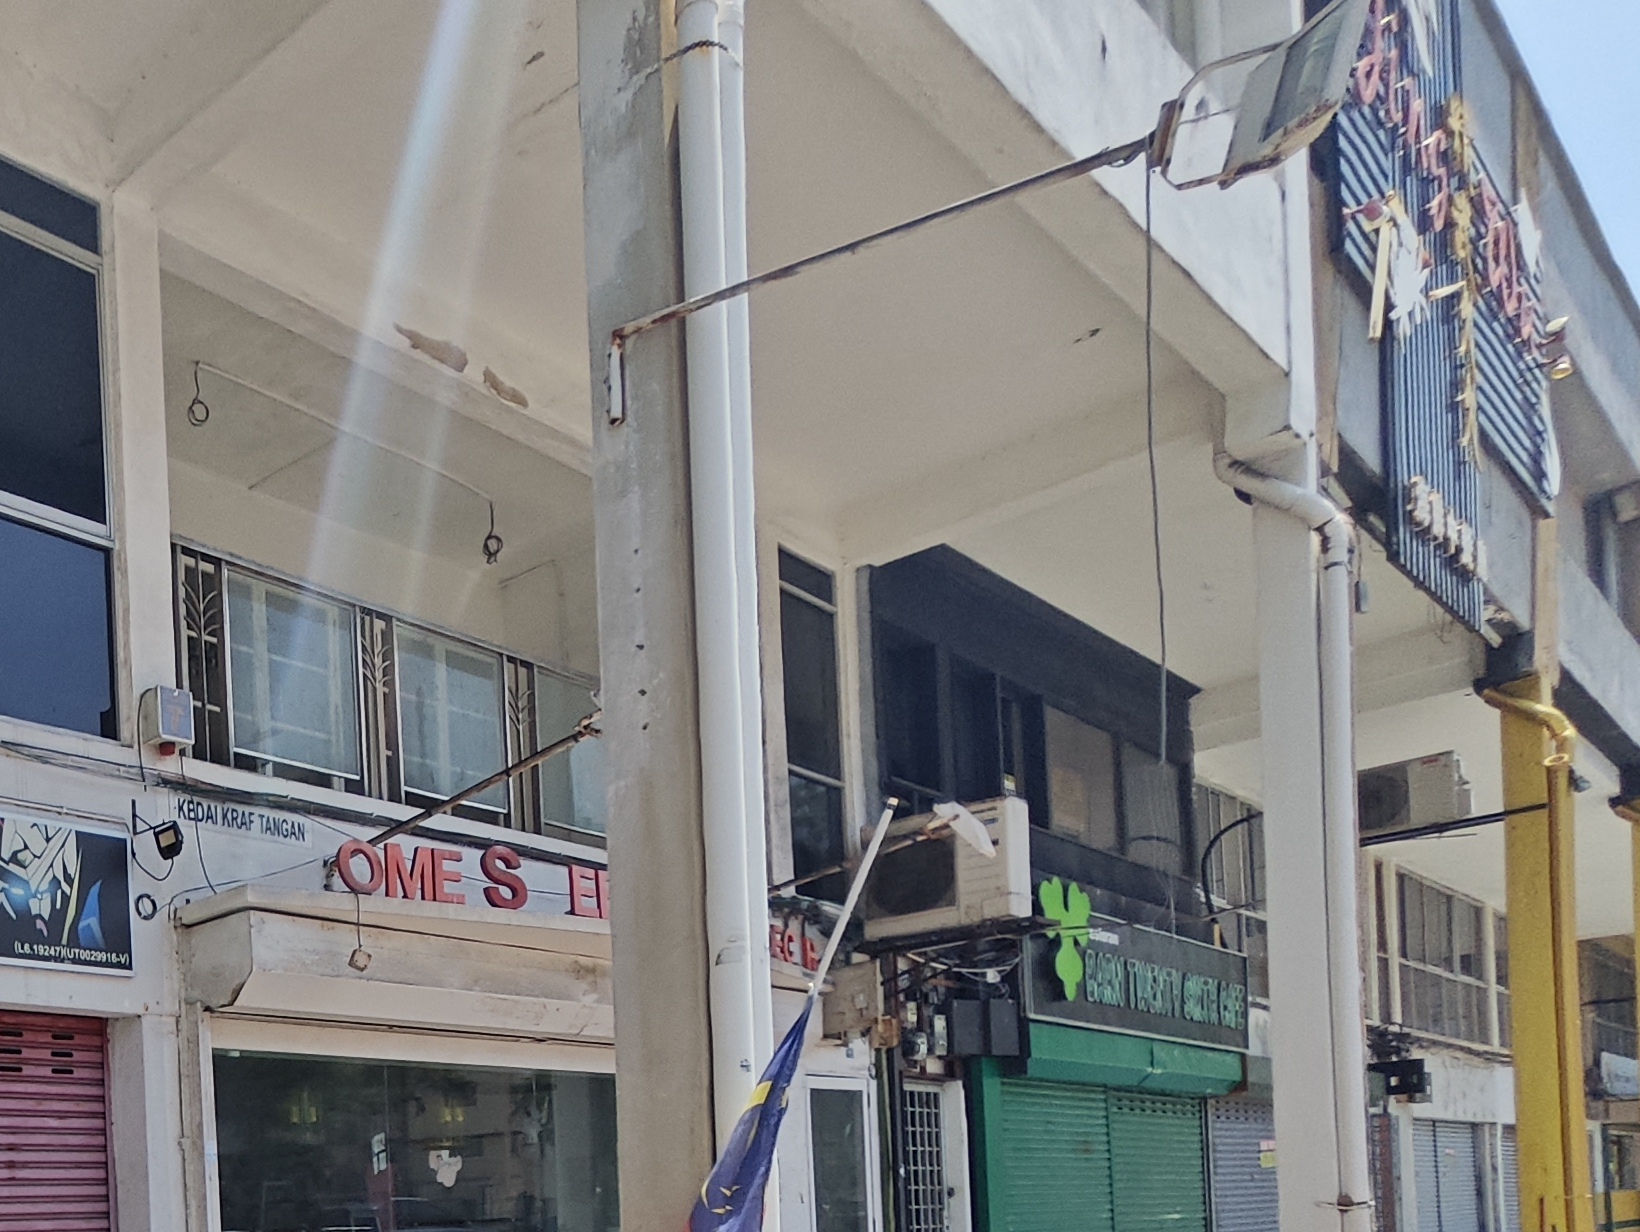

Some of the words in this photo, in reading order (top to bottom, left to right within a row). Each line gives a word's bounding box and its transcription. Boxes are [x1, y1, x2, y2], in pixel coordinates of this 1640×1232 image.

[177, 798, 218, 825] KEDAI
[221, 807, 255, 831] KRAF
[258, 814, 306, 842] TANGAN
